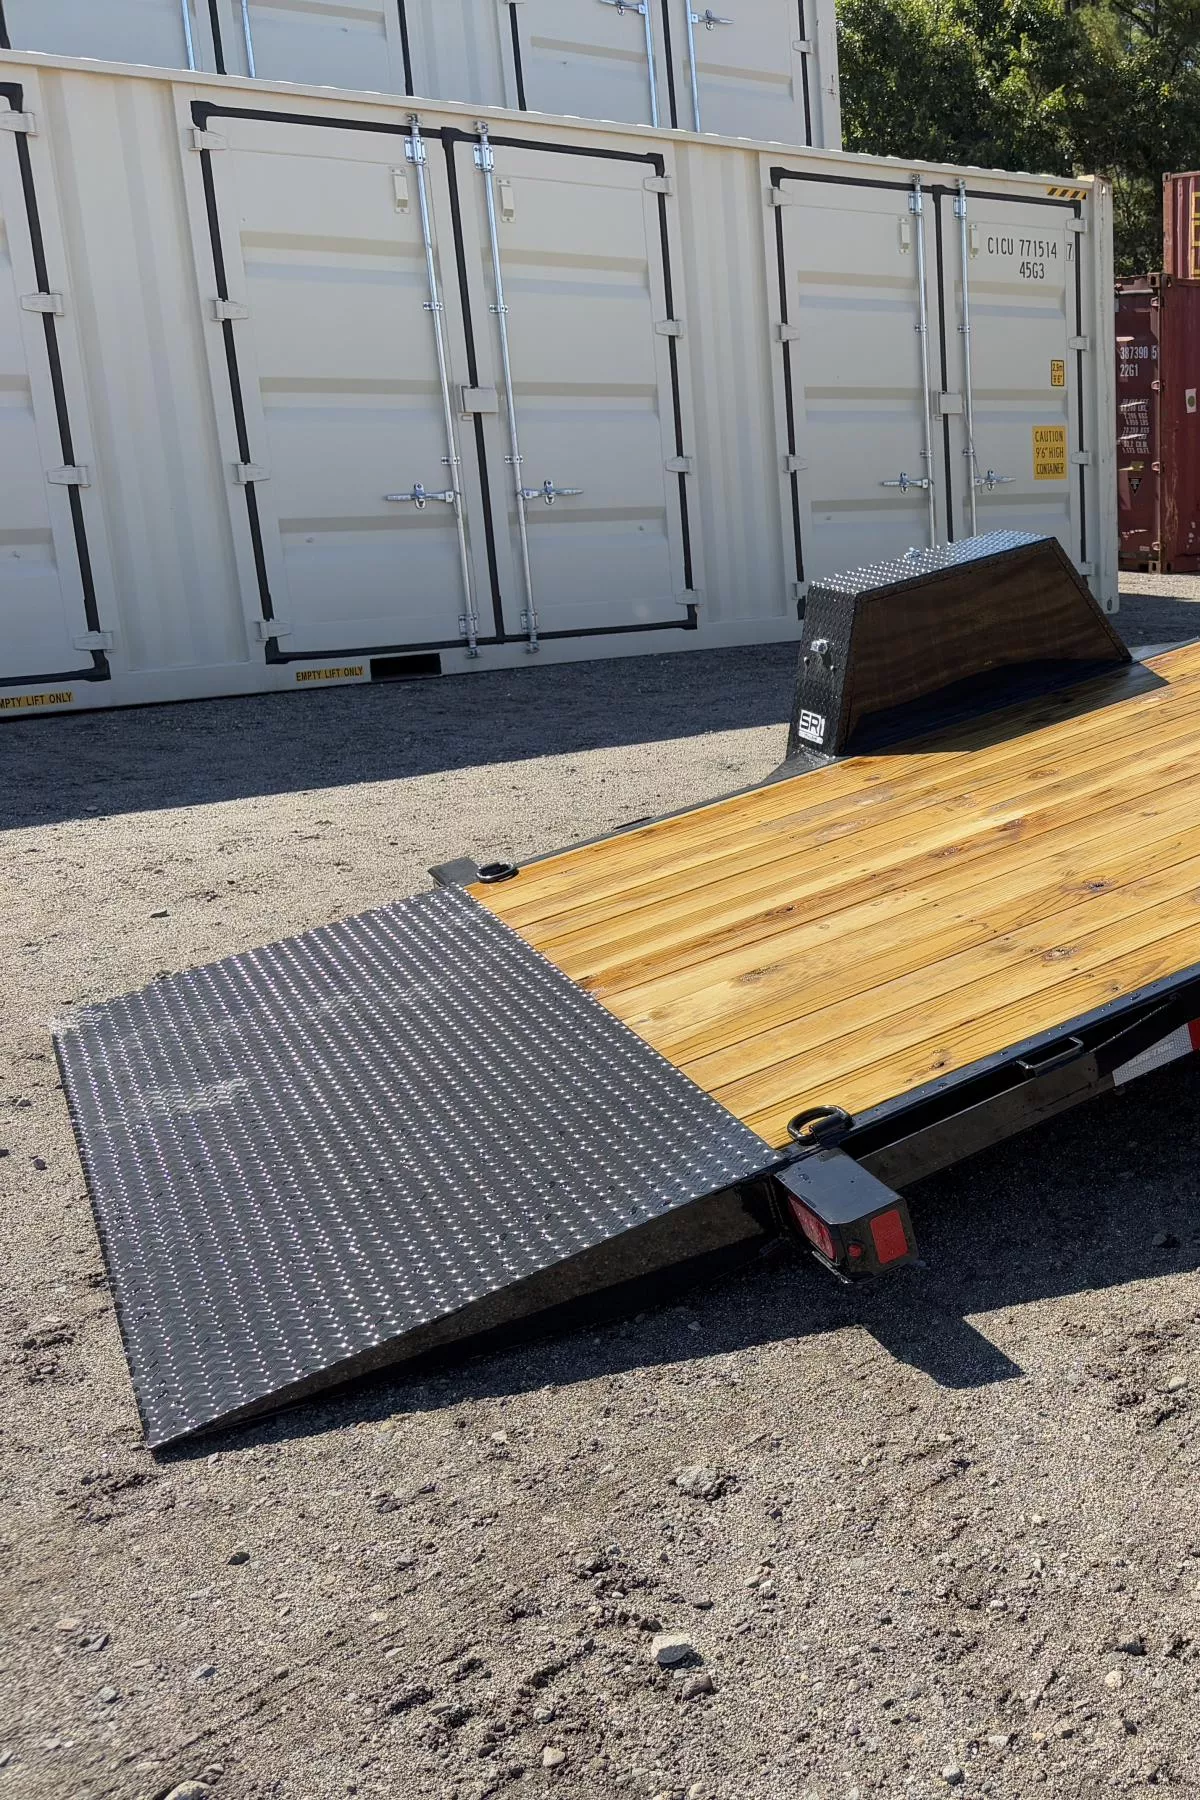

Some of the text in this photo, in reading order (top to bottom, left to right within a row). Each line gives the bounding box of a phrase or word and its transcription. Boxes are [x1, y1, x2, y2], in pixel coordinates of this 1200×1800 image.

[987, 237, 1073, 260] CICU 771514 7
[1019, 261, 1045, 279] 45G3
[1120, 346, 1148, 360] 387390
[1120, 364, 1138, 377] 22G1
[1035, 430, 1063, 442] CAUTION
[1048, 446, 1064, 459] HIGH
[1036, 463, 1064, 475] CONTAINER
[296, 666, 363, 681] EMPTY LIFT ONLY
[26, 695, 44, 706] LIFT
[49, 692, 72, 704] ONLY
